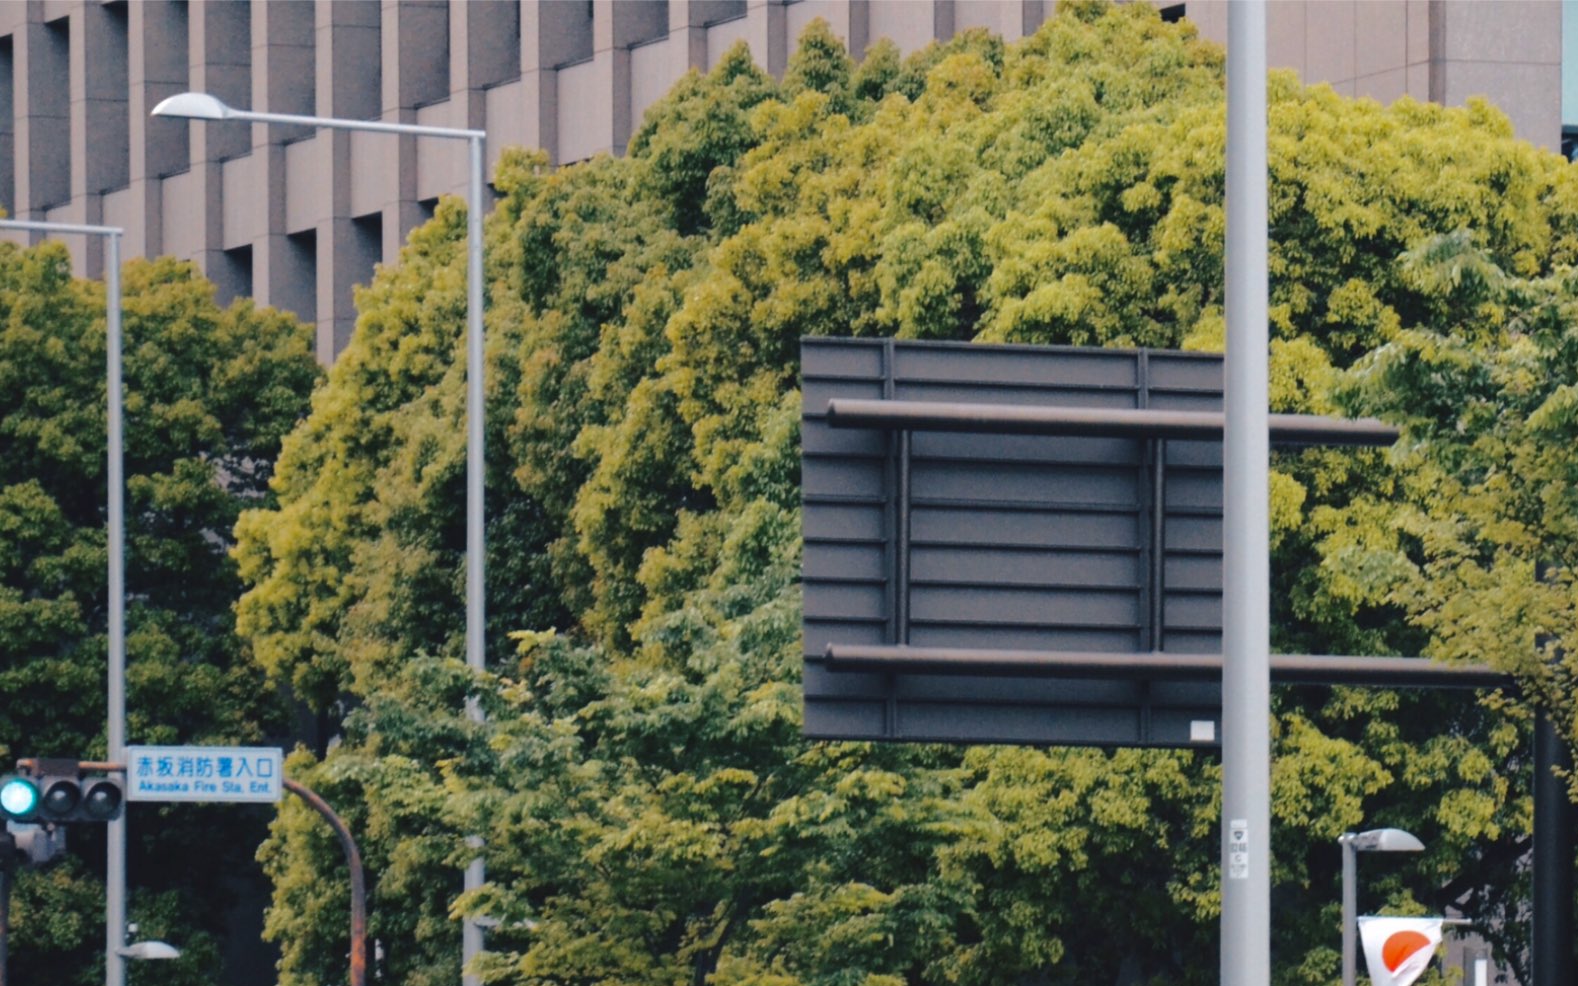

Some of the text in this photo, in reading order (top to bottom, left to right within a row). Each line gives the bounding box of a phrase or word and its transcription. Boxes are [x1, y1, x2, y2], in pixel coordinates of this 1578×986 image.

[136, 756, 273, 778] 赤坂消防署入口
[139, 780, 272, 793] Akasaka Fire Sta. Ent.
